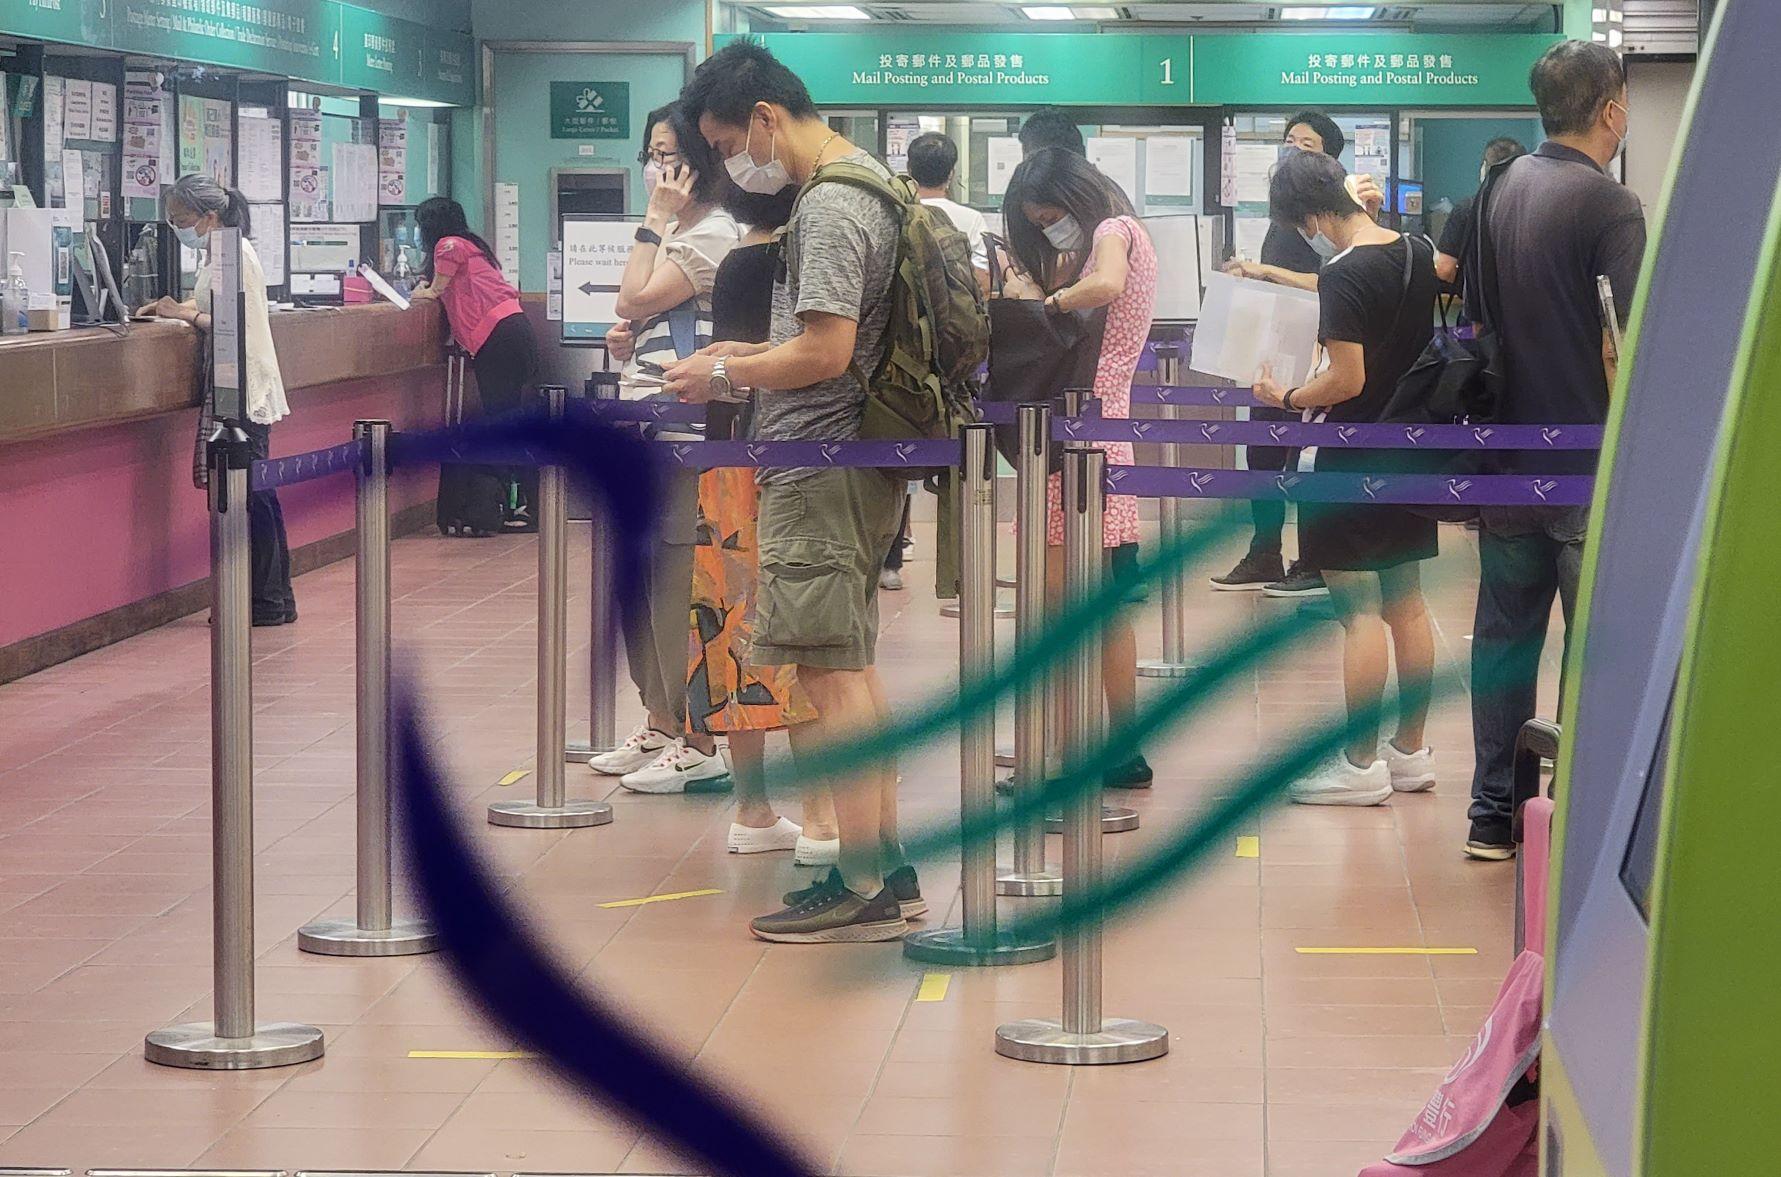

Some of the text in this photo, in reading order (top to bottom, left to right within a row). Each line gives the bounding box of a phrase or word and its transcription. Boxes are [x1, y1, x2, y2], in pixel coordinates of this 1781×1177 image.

[332, 31, 339, 59] 4
[879, 54, 1024, 68] 投寄郵件及郵品發售
[1308, 54, 1452, 68] 投寄郵件及郵品發售
[1159, 58, 1174, 84] 1
[852, 72, 1049, 87] Mail Posting and Postal Products
[1281, 72, 1478, 87] Mail Posting and Postal Products
[569, 257, 593, 266] Please
[595, 257, 612, 266] wait
